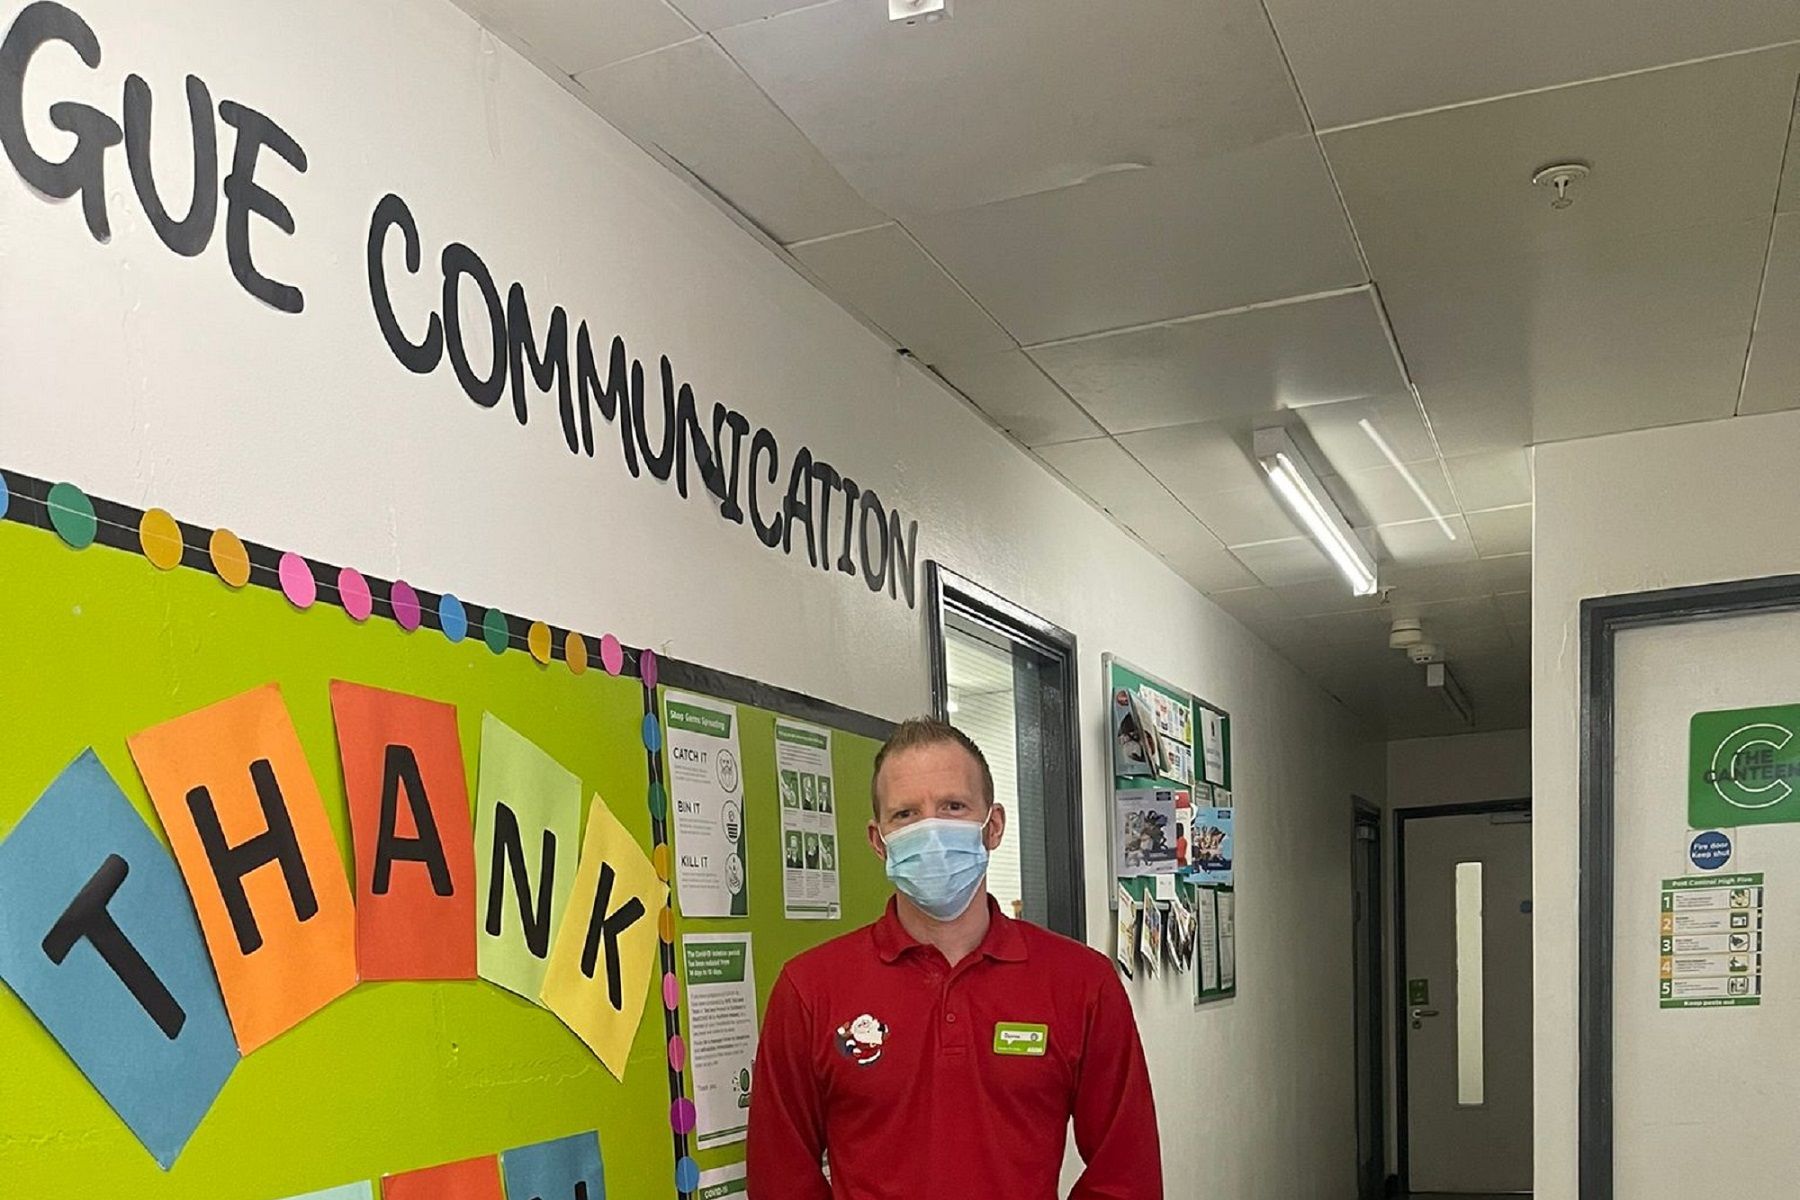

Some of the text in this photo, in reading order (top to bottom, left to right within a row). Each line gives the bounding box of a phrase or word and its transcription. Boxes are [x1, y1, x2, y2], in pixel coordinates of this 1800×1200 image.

[0, 0, 919, 609] GUE COMMUNICATION
[673, 747, 707, 763] CATCH IT
[1735, 749, 1774, 765] THE
[678, 800, 700, 814] BIN IT
[1710, 842, 1729, 850] door
[1692, 849, 1730, 859] Keep shut
[681, 854, 708, 868] KILL IT
[42, 744, 646, 1040] THANK
[1663, 896, 1670, 908] 1
[1663, 918, 1671, 931] 2
[1662, 939, 1671, 951] 3
[1662, 960, 1670, 973] 4
[1662, 982, 1670, 994] 5
